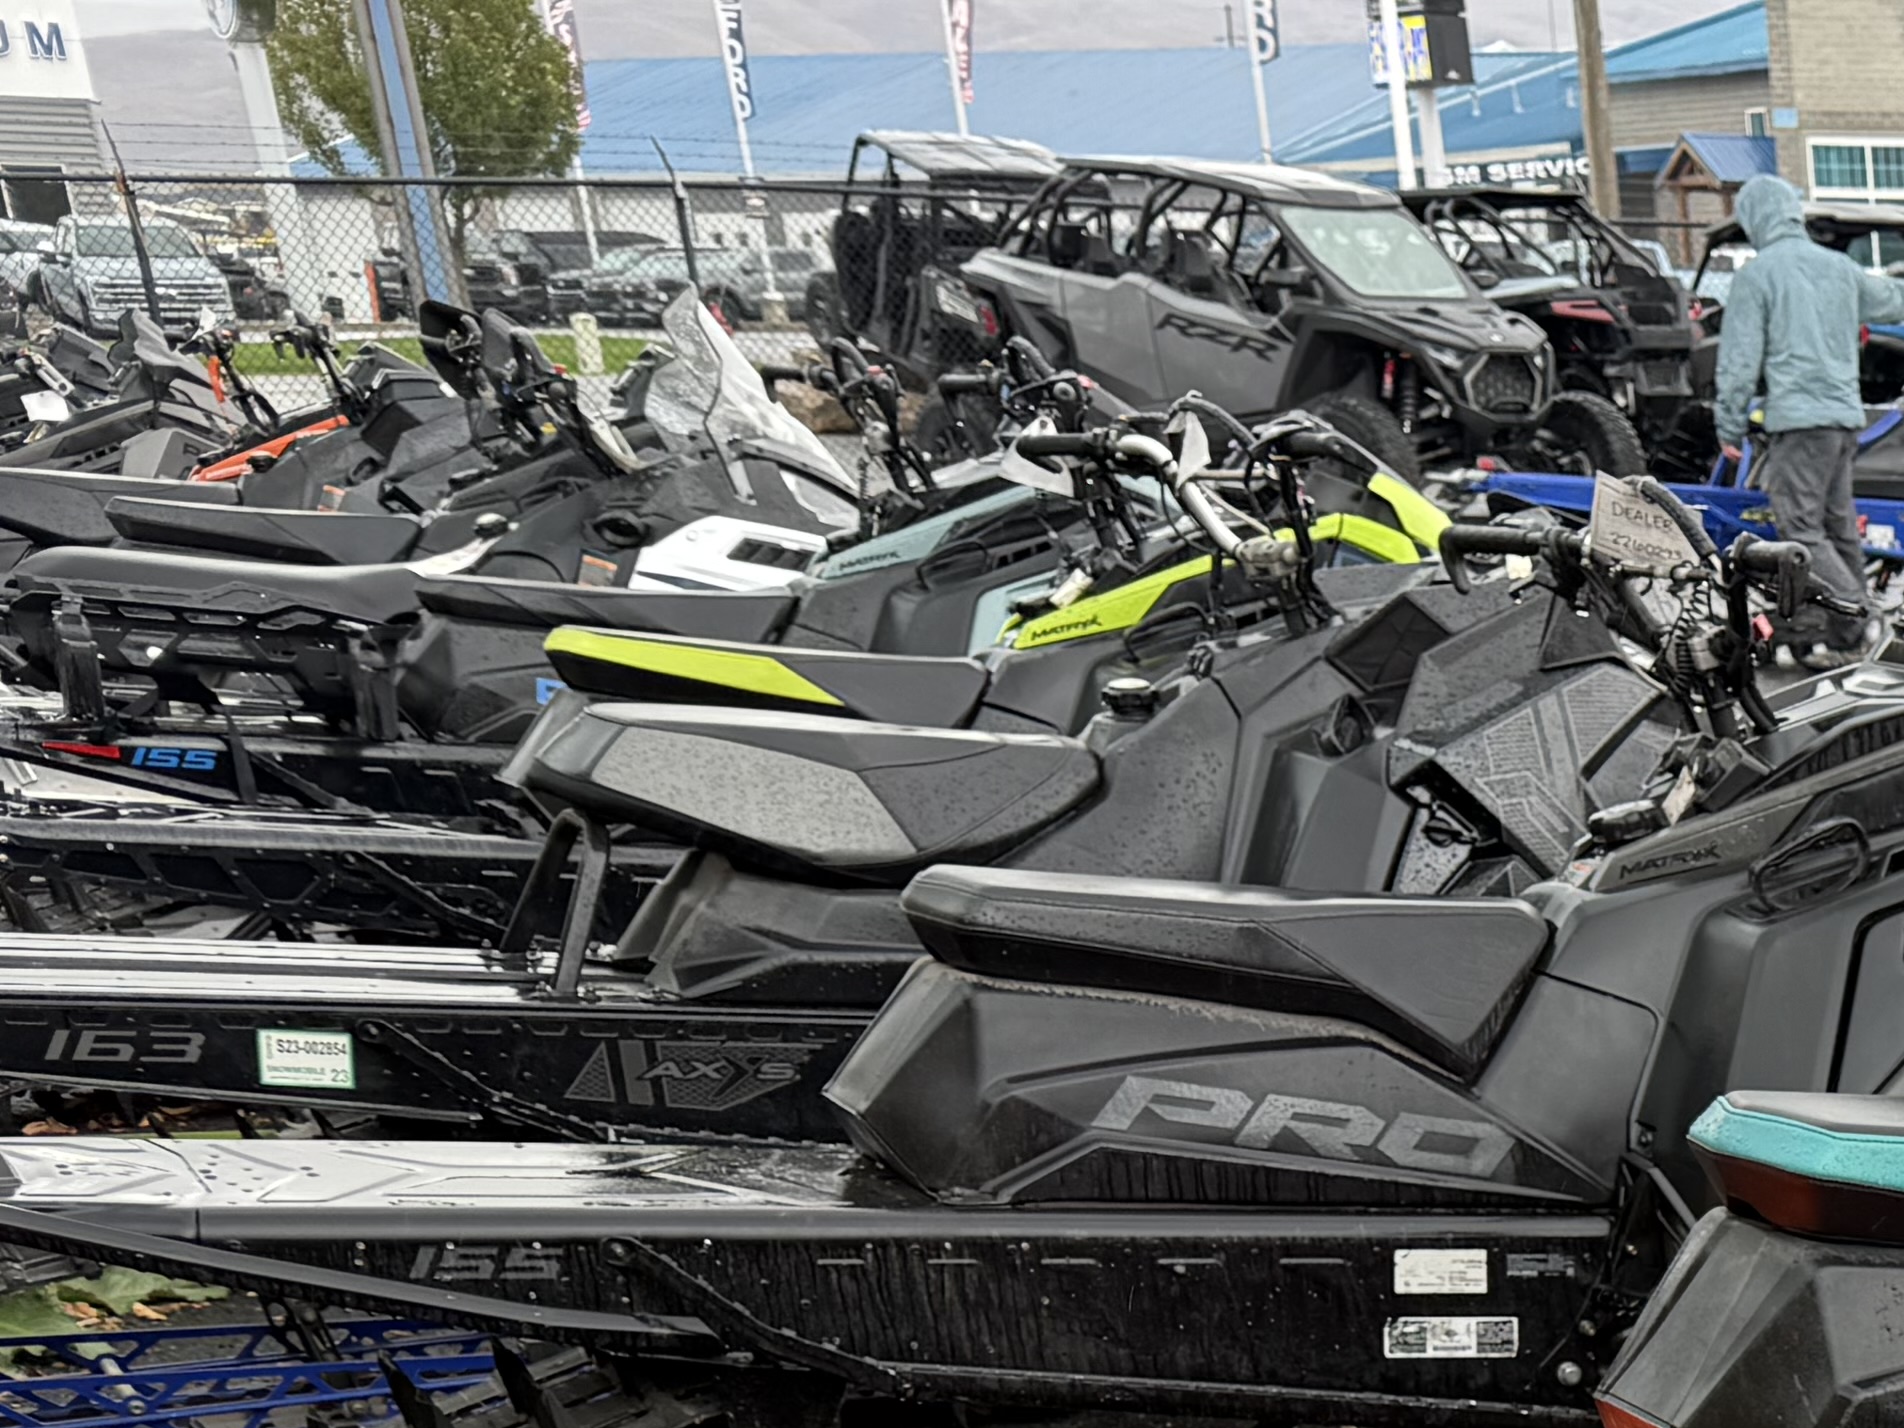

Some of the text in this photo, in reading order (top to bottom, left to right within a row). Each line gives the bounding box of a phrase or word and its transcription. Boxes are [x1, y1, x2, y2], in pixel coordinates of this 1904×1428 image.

[1487, 156, 1592, 183] SERVIC
[131, 747, 217, 770] 155
[44, 1029, 206, 1064] 163
[1091, 1075, 1517, 1178] PRO
[410, 1245, 563, 1281] 155
